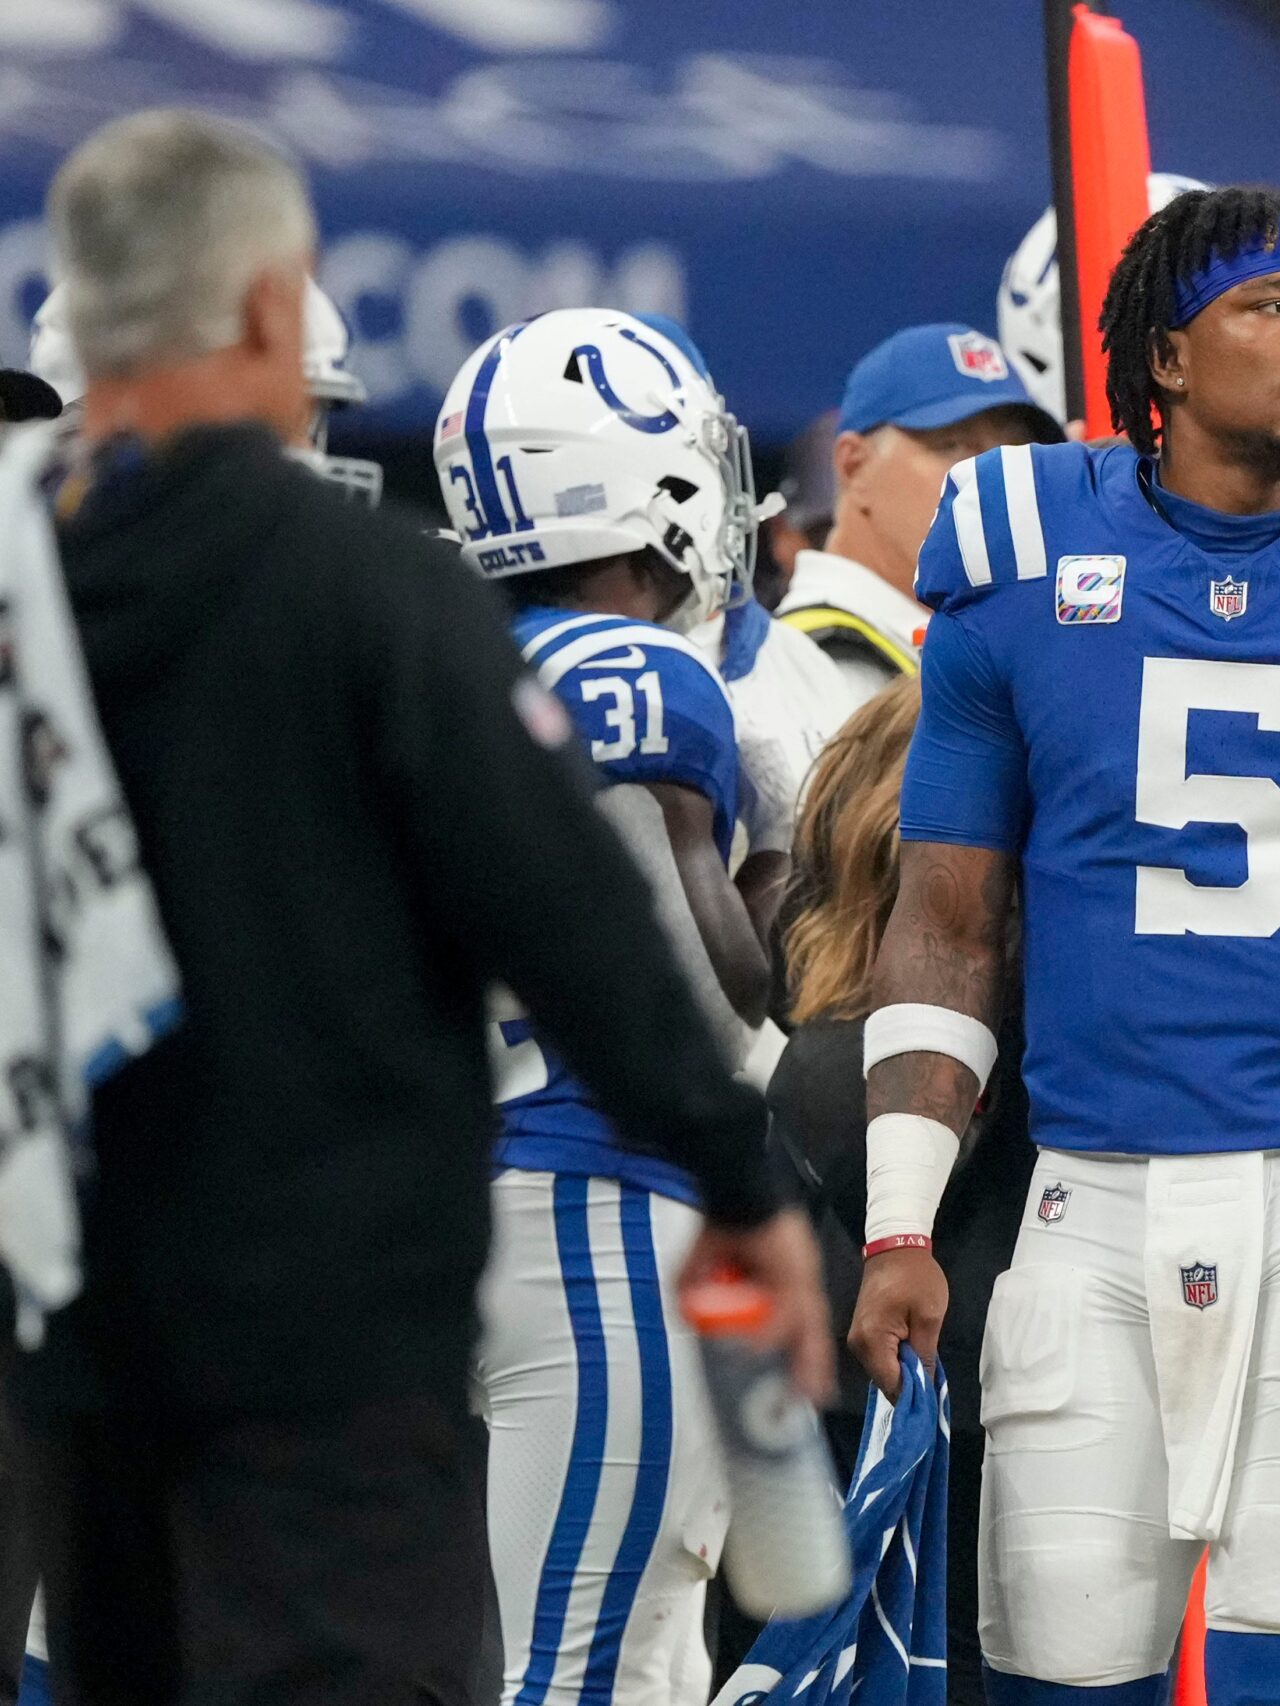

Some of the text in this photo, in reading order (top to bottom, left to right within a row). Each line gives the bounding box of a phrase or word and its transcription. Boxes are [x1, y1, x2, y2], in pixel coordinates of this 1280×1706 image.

[450, 456, 535, 541] 31
[476, 540, 546, 574] COLTS
[1061, 559, 1119, 606] C
[1216, 596, 1241, 612] NFL
[580, 670, 669, 762] 31
[1040, 1200, 1062, 1219] NFL
[1186, 1282, 1217, 1305] NFL
